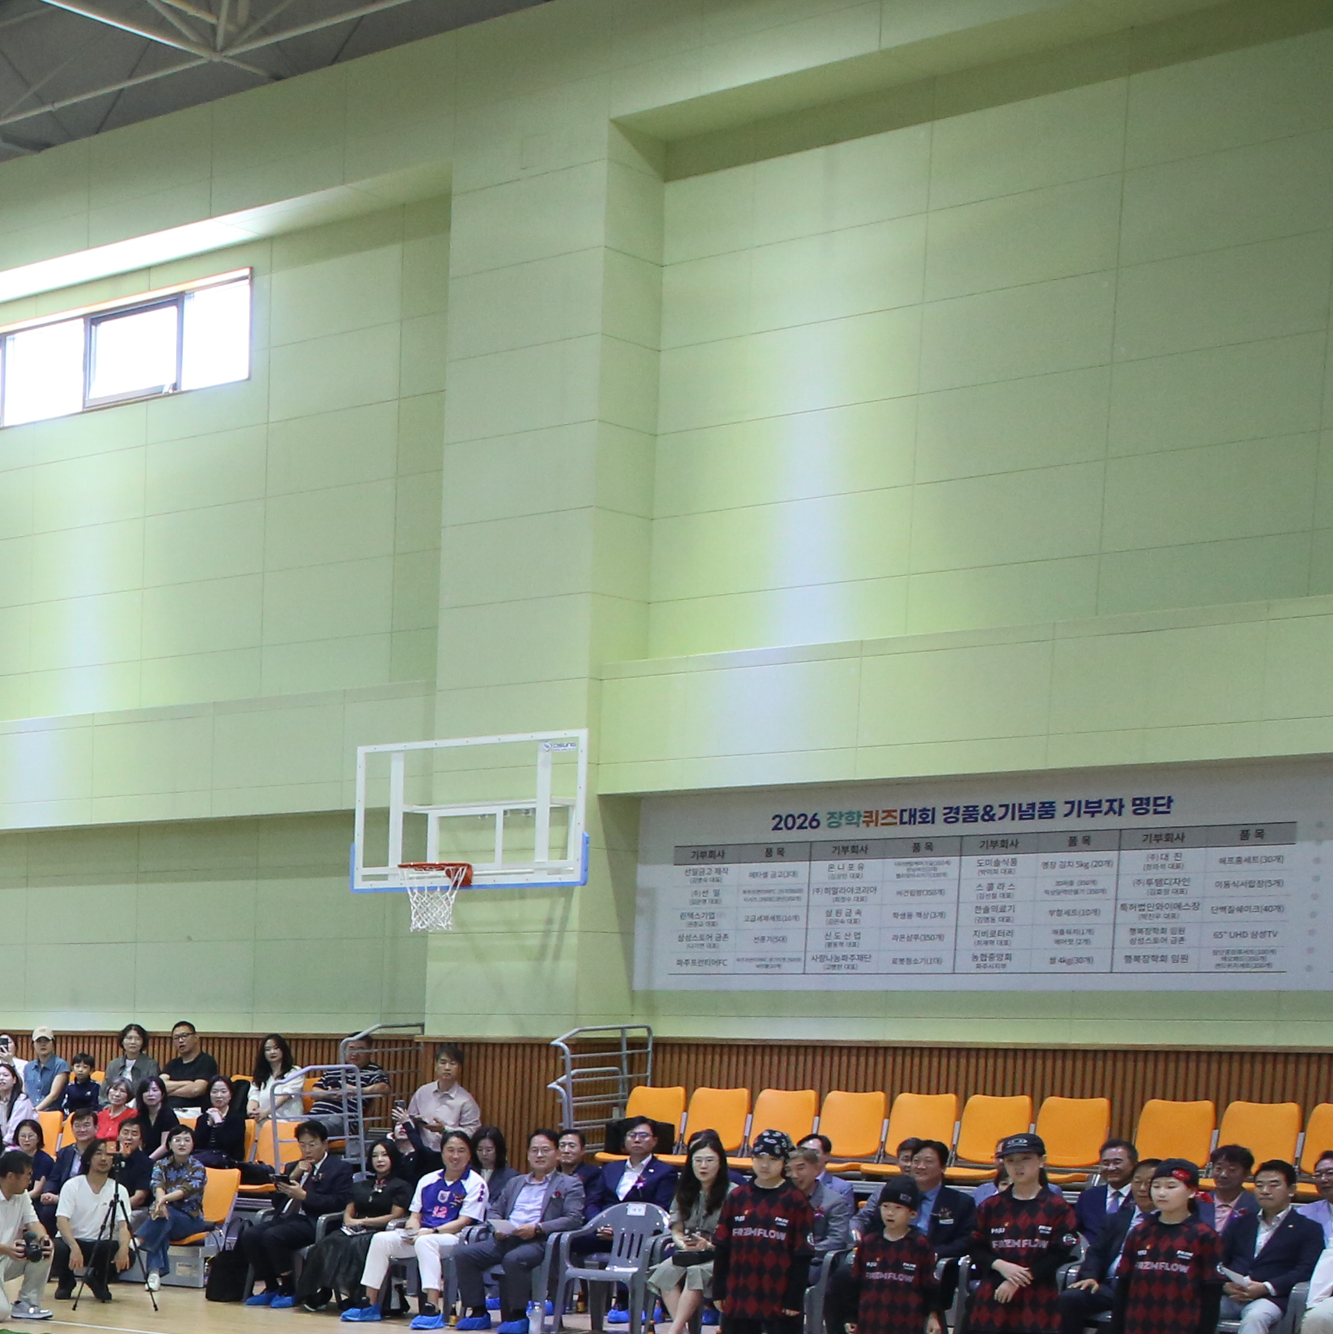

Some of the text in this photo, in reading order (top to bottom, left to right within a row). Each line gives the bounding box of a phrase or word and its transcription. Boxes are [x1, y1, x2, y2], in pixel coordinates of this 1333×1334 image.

[771, 794, 1175, 831] 2026 장학퀴즈대회 경품&기념품 기부자 명단
[1228, 931, 1249, 939] UHD
